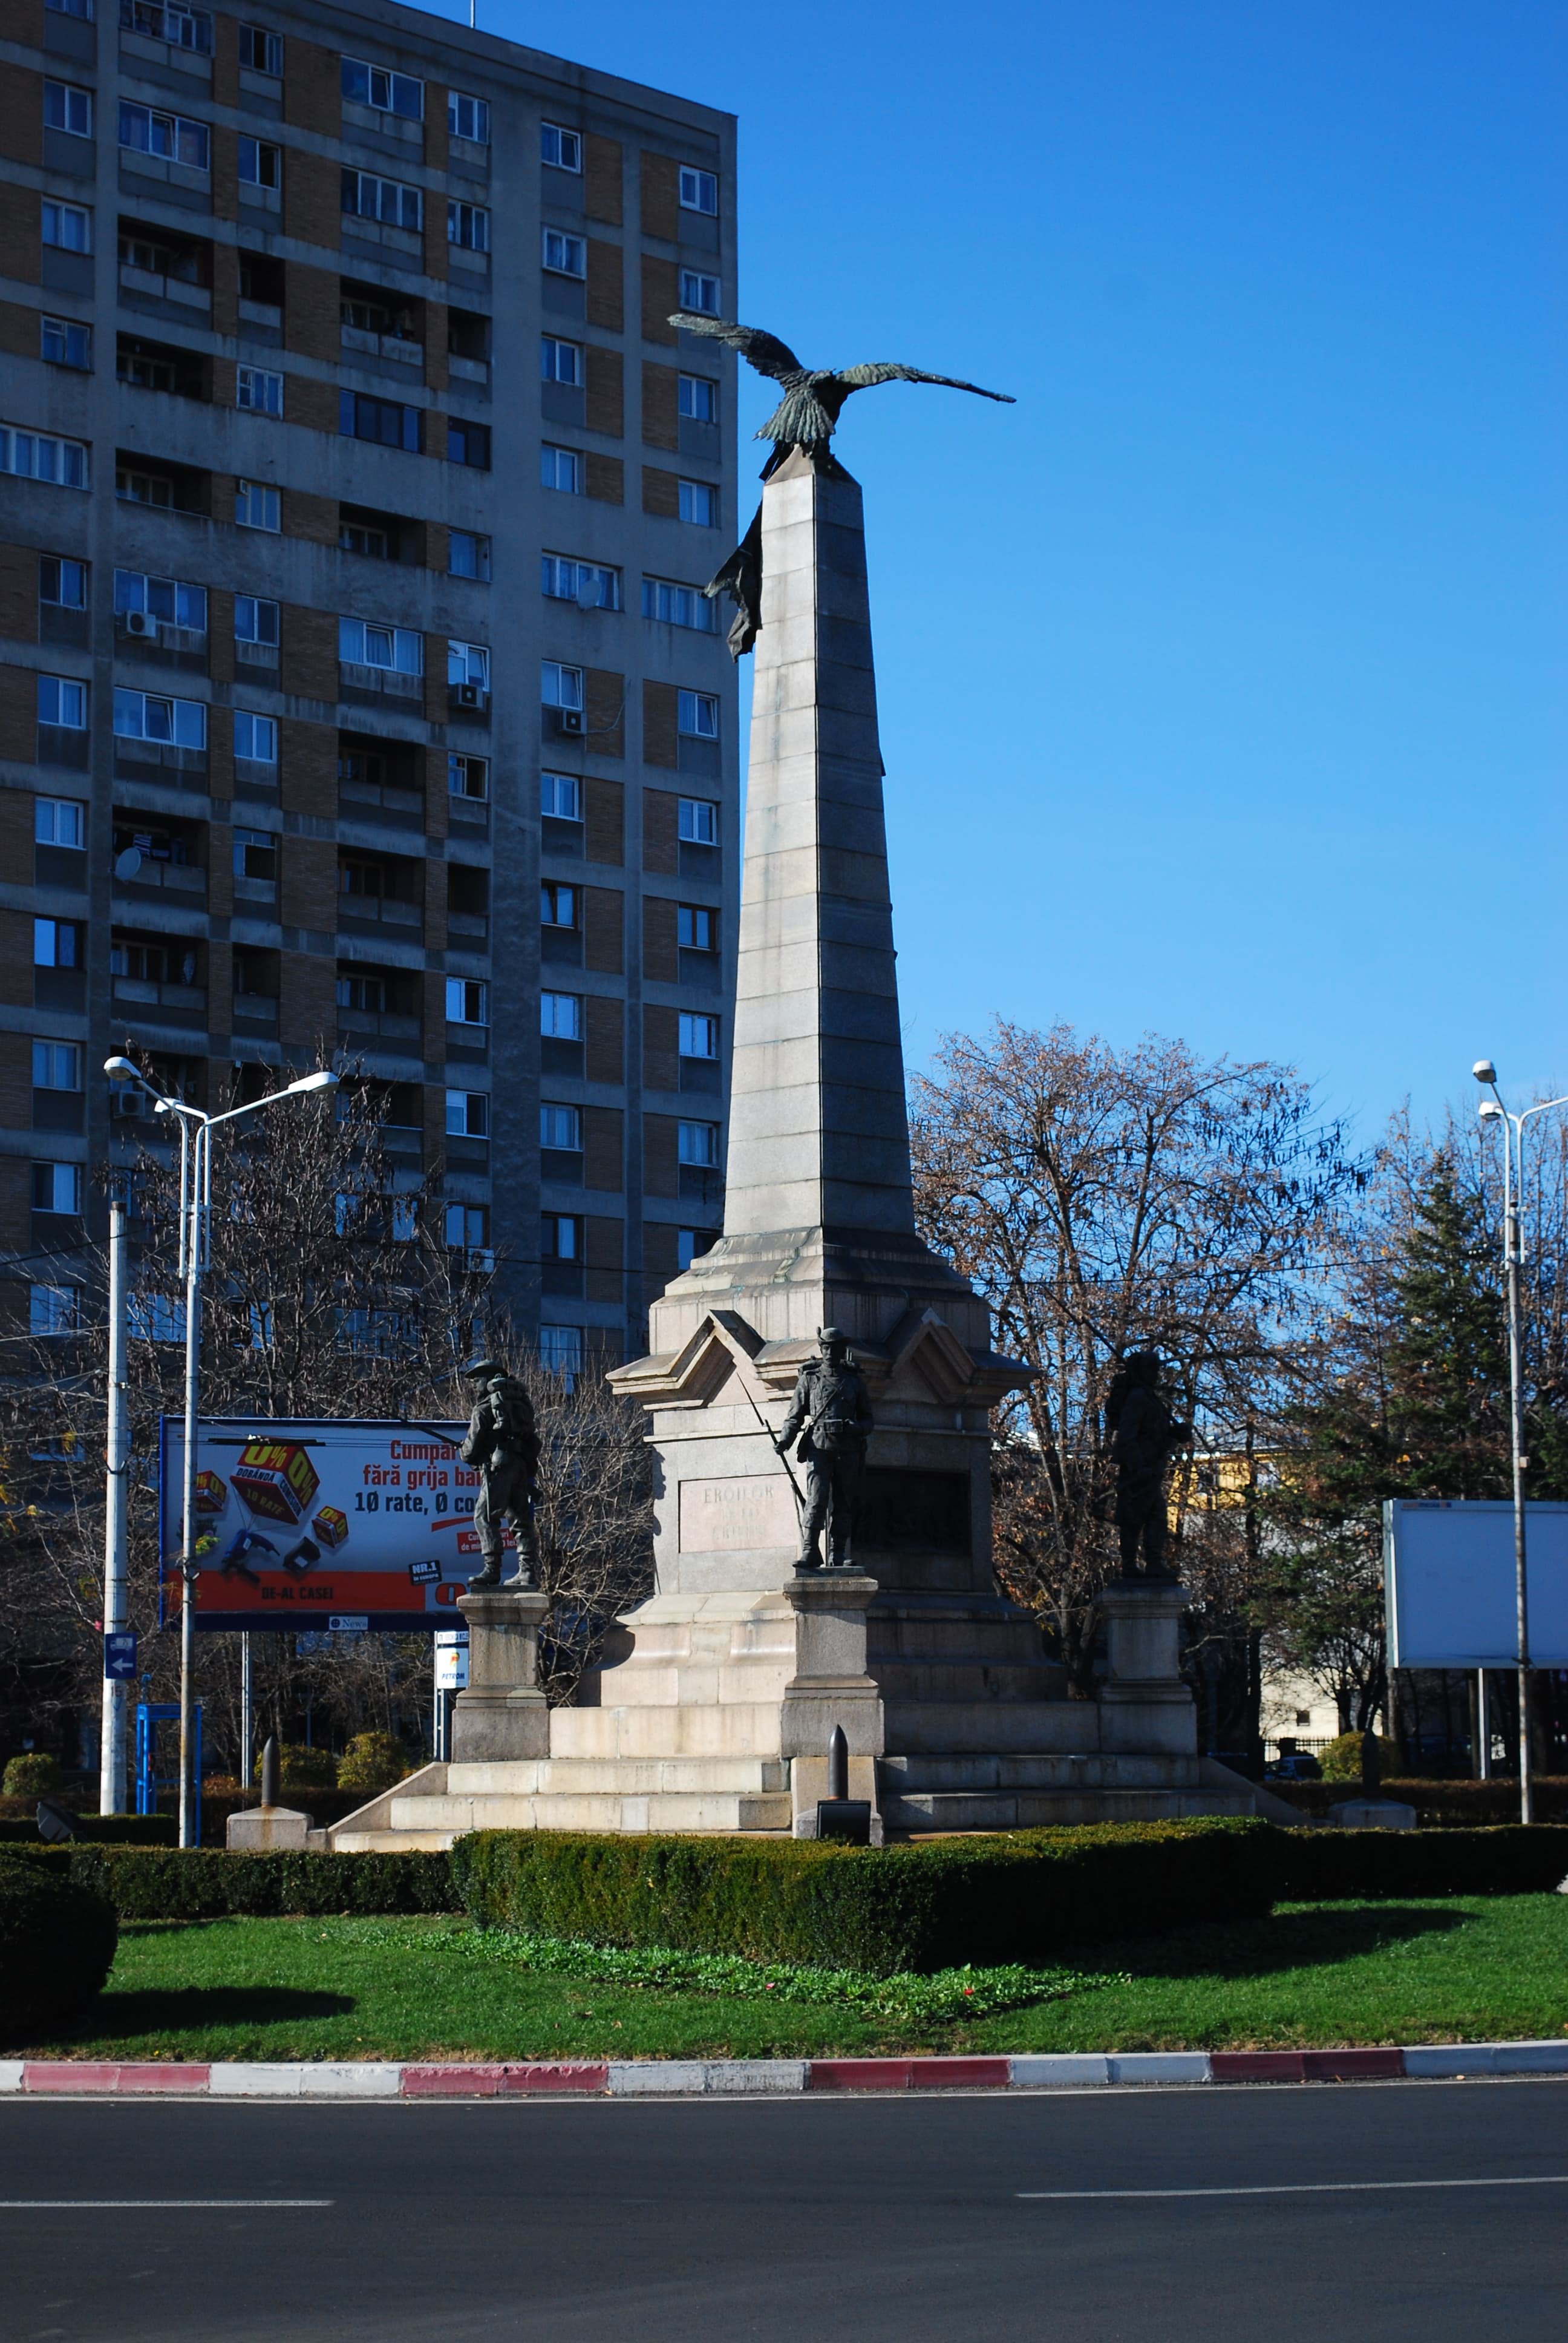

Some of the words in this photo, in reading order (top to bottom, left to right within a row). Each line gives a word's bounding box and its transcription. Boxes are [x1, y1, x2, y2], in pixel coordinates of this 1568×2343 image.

[363, 1464, 400, 1485] fără
[408, 1466, 448, 1491] grija
[386, 1493, 428, 1515] rate,
[455, 1496, 478, 1512] co
[412, 1562, 437, 1574] NR.1
[299, 1587, 334, 1600] CASEI
[436, 1582, 468, 1606] O
